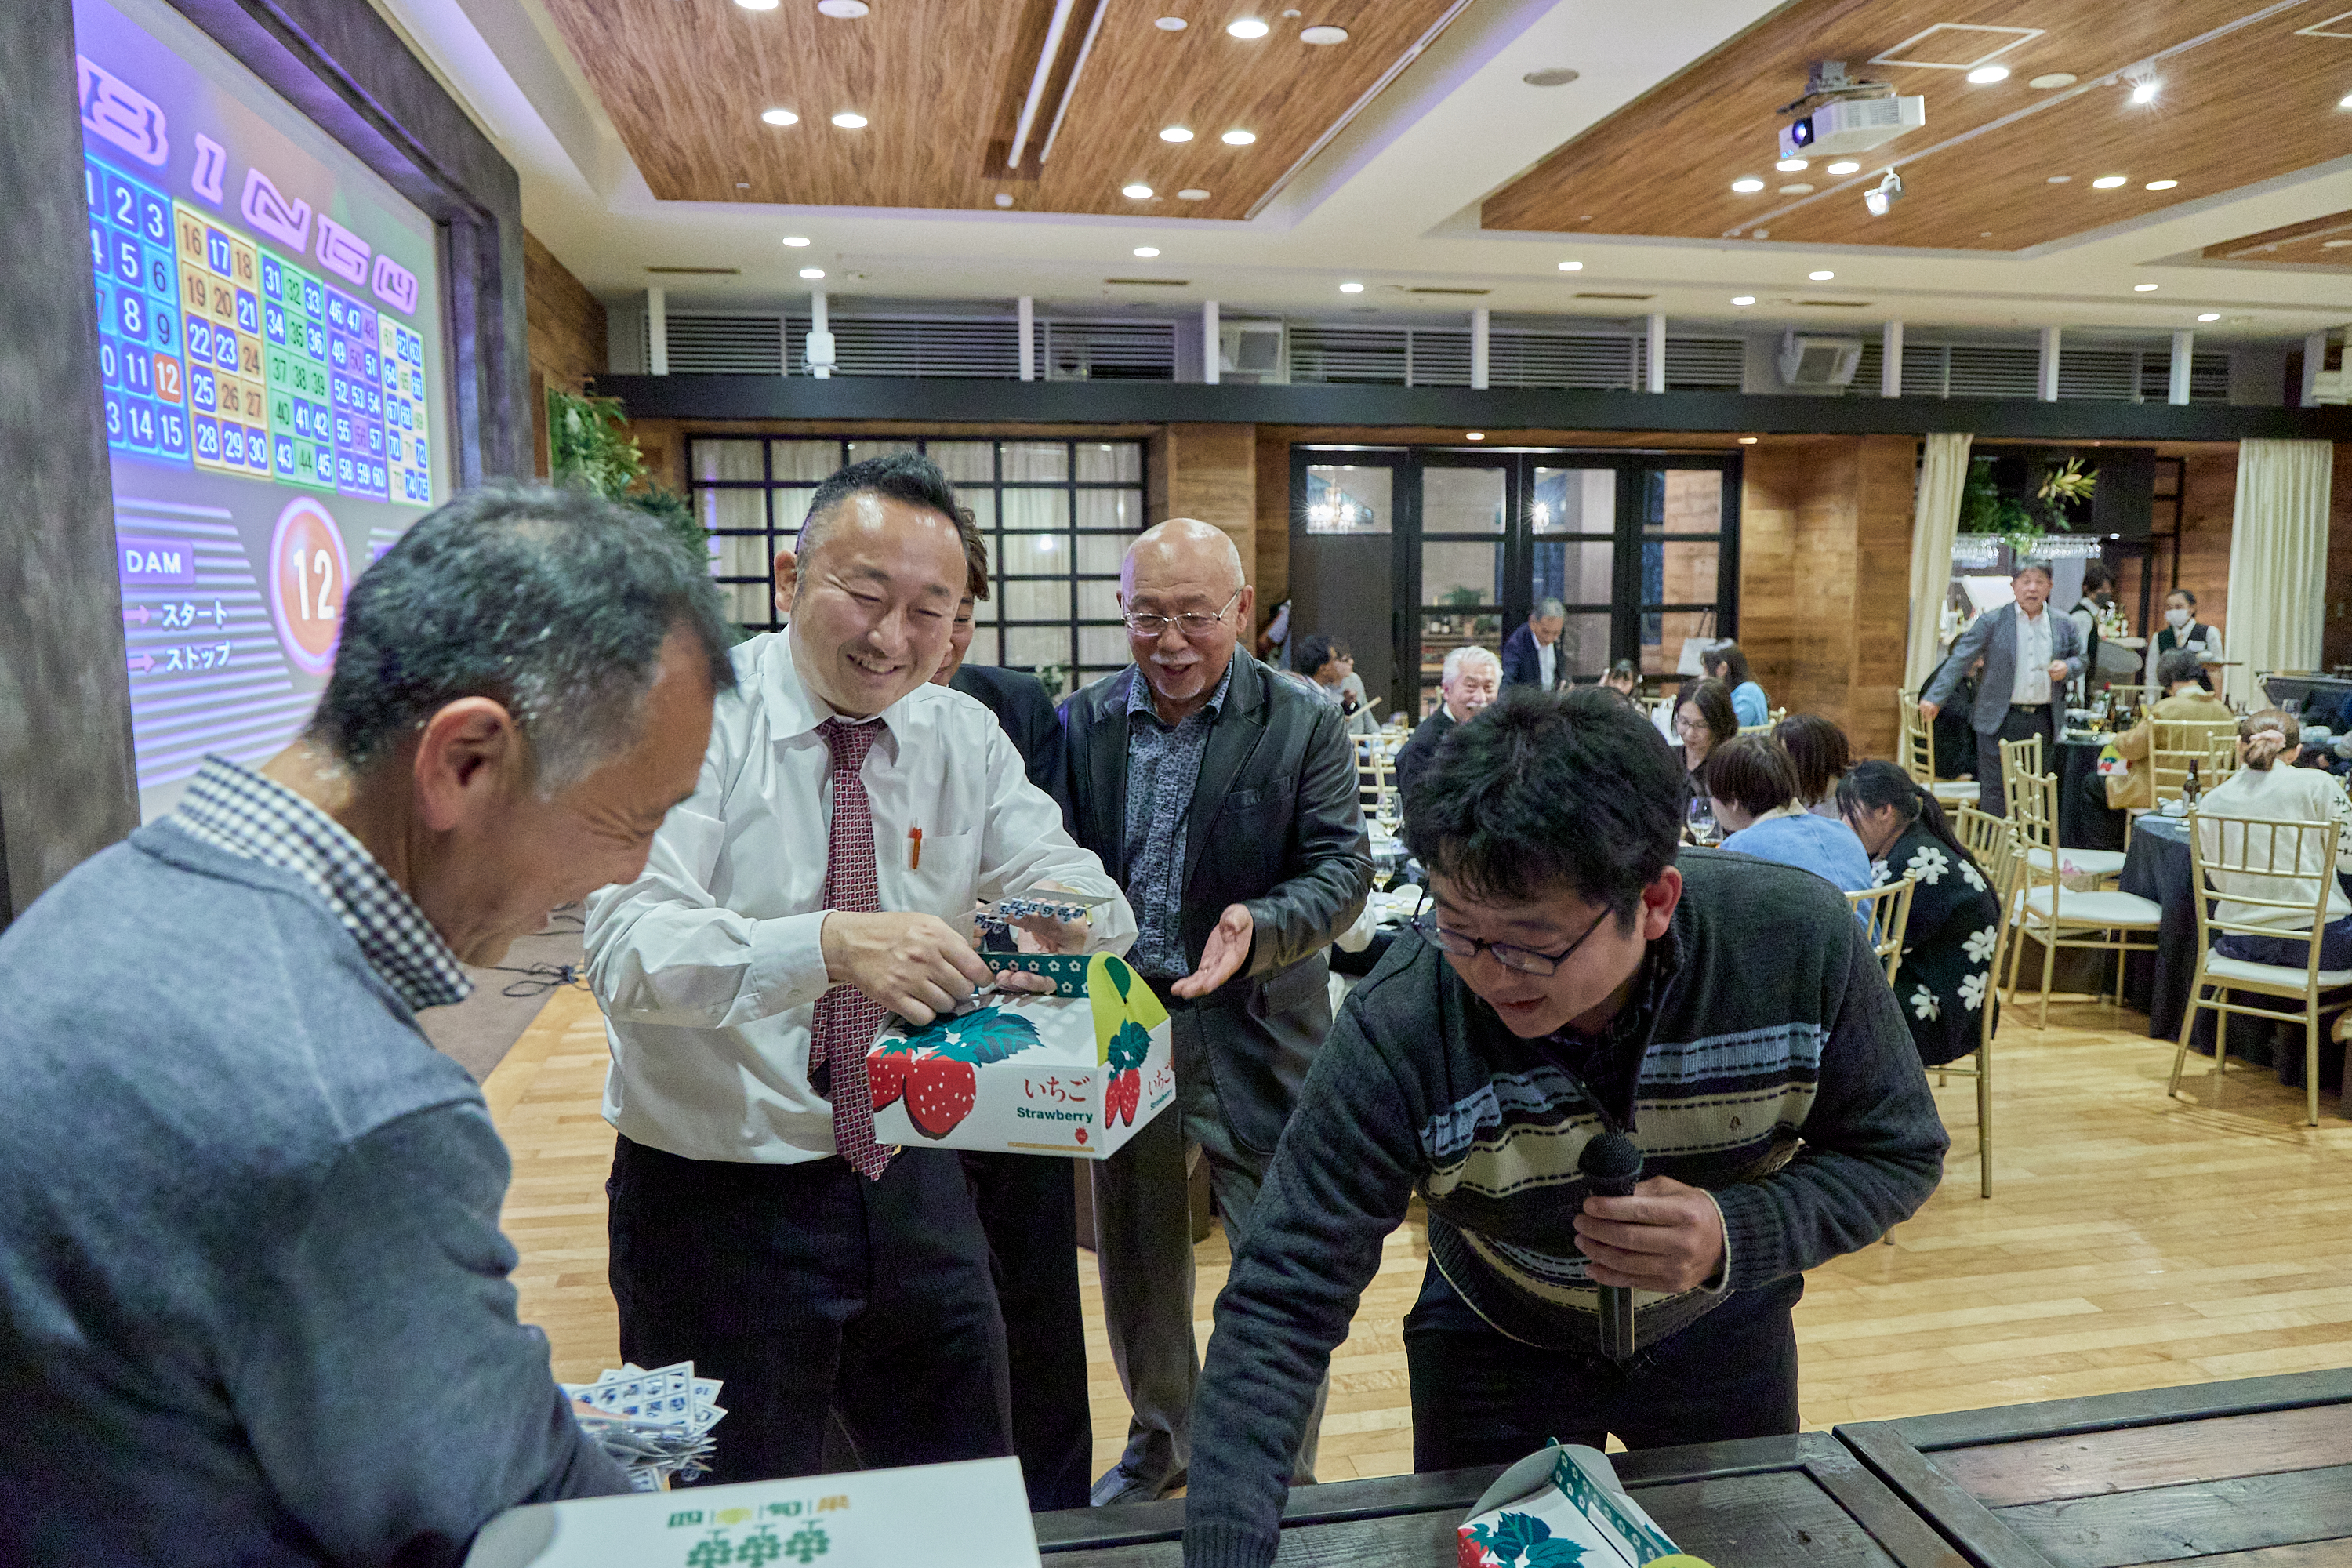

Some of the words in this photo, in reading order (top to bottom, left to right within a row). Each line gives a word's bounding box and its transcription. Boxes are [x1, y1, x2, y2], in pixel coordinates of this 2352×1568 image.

[116, 187, 134, 225] 2
[147, 203, 164, 238] 3
[122, 242, 138, 278] 5
[154, 261, 165, 292] 6
[183, 223, 201, 255] 16
[209, 238, 229, 270] 17
[236, 250, 252, 279] 18
[188, 275, 205, 307] 19
[214, 287, 232, 318] 20
[238, 297, 256, 328] 21
[265, 265, 281, 295] 31
[287, 279, 301, 305] 32
[305, 286, 321, 314] 33
[124, 297, 141, 332] 8
[158, 314, 169, 344] 9
[267, 309, 284, 337] 34
[290, 321, 303, 347] 35
[307, 328, 323, 354] 36
[329, 299, 343, 325] 46
[347, 308, 361, 332] 47
[189, 323, 211, 357] 22
[216, 333, 237, 364] 23
[243, 346, 259, 375] 24
[365, 354, 377, 376] 51
[101, 344, 115, 377] 0
[125, 352, 147, 386] 11
[157, 361, 180, 394] 12
[274, 358, 286, 383] 37
[294, 365, 307, 390] 38
[313, 372, 325, 396] 39
[193, 373, 214, 405] 25
[222, 383, 239, 411] 26
[246, 390, 261, 417] 27
[334, 379, 348, 404] 52
[352, 385, 365, 409] 53
[368, 391, 381, 414] 54
[387, 400, 398, 421] 67
[107, 401, 121, 434] 3
[129, 407, 154, 441] 14
[160, 414, 183, 446] 15
[277, 401, 289, 425] 40
[296, 406, 310, 431] 41
[314, 411, 328, 437] 42
[336, 419, 351, 443] 55
[369, 428, 382, 450] 57
[197, 424, 218, 453] 28
[224, 430, 244, 459] 29
[249, 436, 267, 463] 30
[277, 443, 293, 469] 43
[299, 449, 312, 472] 44
[317, 453, 331, 477] 45
[388, 434, 401, 456] 70
[339, 458, 354, 481] 58
[357, 462, 371, 485] 59
[405, 474, 416, 494] 74
[125, 550, 181, 574] DAM
[293, 549, 335, 620] 12
[162, 598, 227, 627] スタート
[166, 641, 230, 671] ストップ
[1025, 1076, 1091, 1103] いちご
[1017, 1107, 1093, 1123] Strawberry
